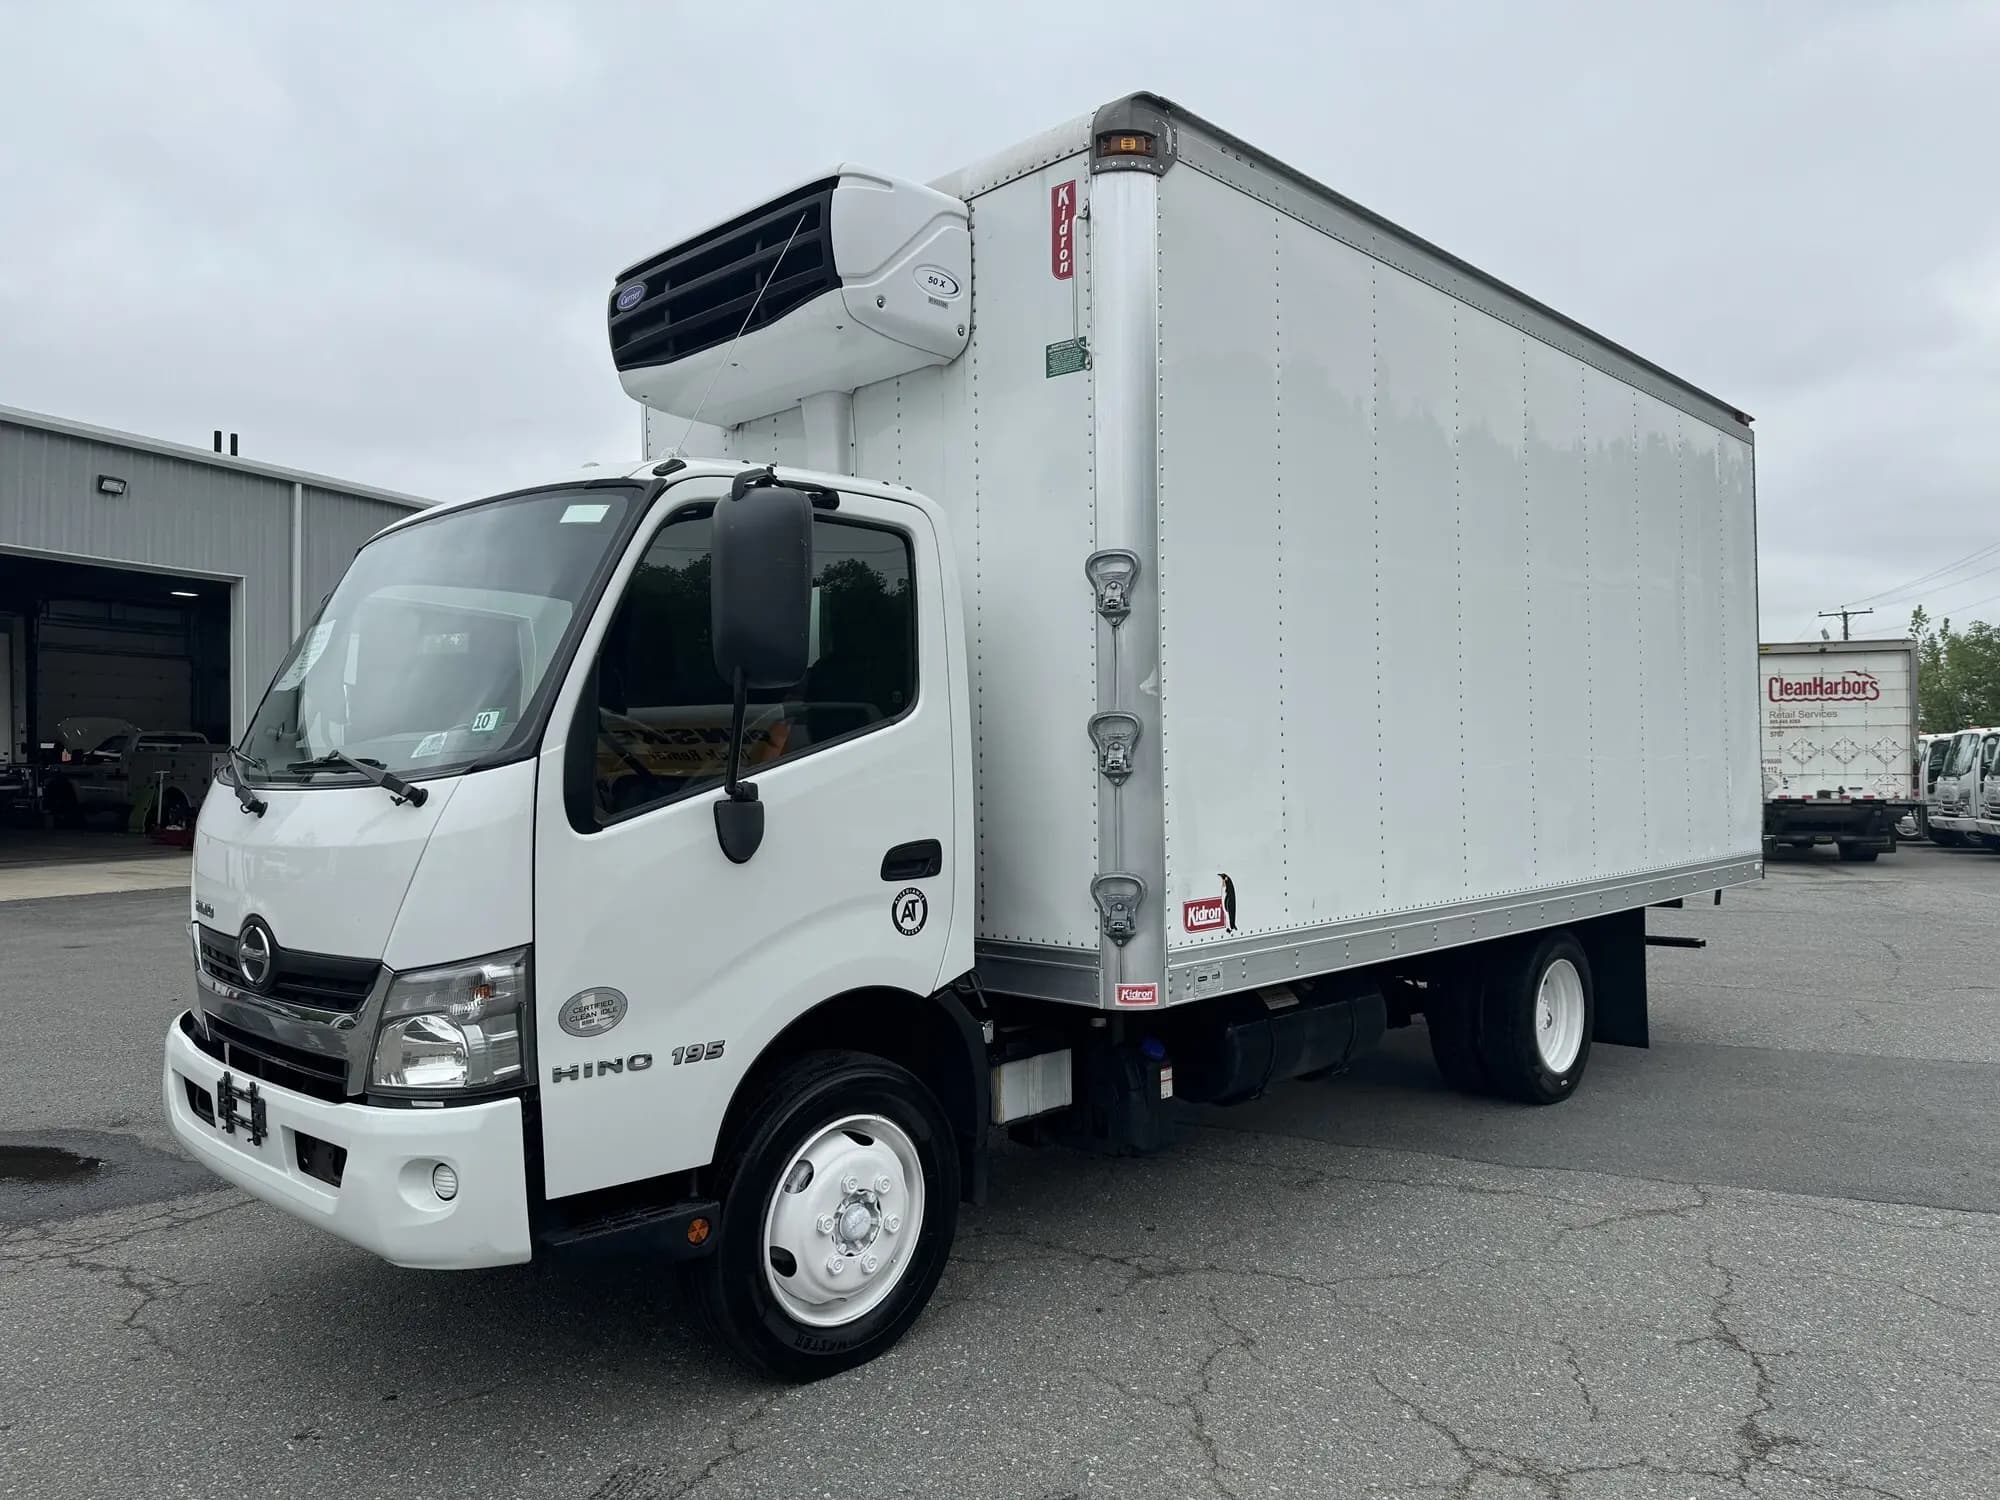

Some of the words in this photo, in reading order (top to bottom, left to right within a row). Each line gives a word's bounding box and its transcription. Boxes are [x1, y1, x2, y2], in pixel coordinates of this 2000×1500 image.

[1057, 186, 1070, 274] Kidron
[928, 276, 938, 286] 50
[940, 280, 946, 288] X
[1768, 676, 1880, 702] CleanHarbors
[472, 713, 491, 729] 10
[1769, 711, 1795, 719] Retail
[1798, 710, 1838, 719] Services
[900, 899, 919, 923] AT
[1188, 905, 1222, 927] Kidron
[1121, 989, 1153, 1001] Kidron
[569, 1011, 597, 1022] CLEAN
[600, 1007, 618, 1015] IDLE
[573, 1000, 614, 1014] CERTIFIED
[552, 1053, 653, 1083] HINO
[671, 1040, 726, 1066] 195
